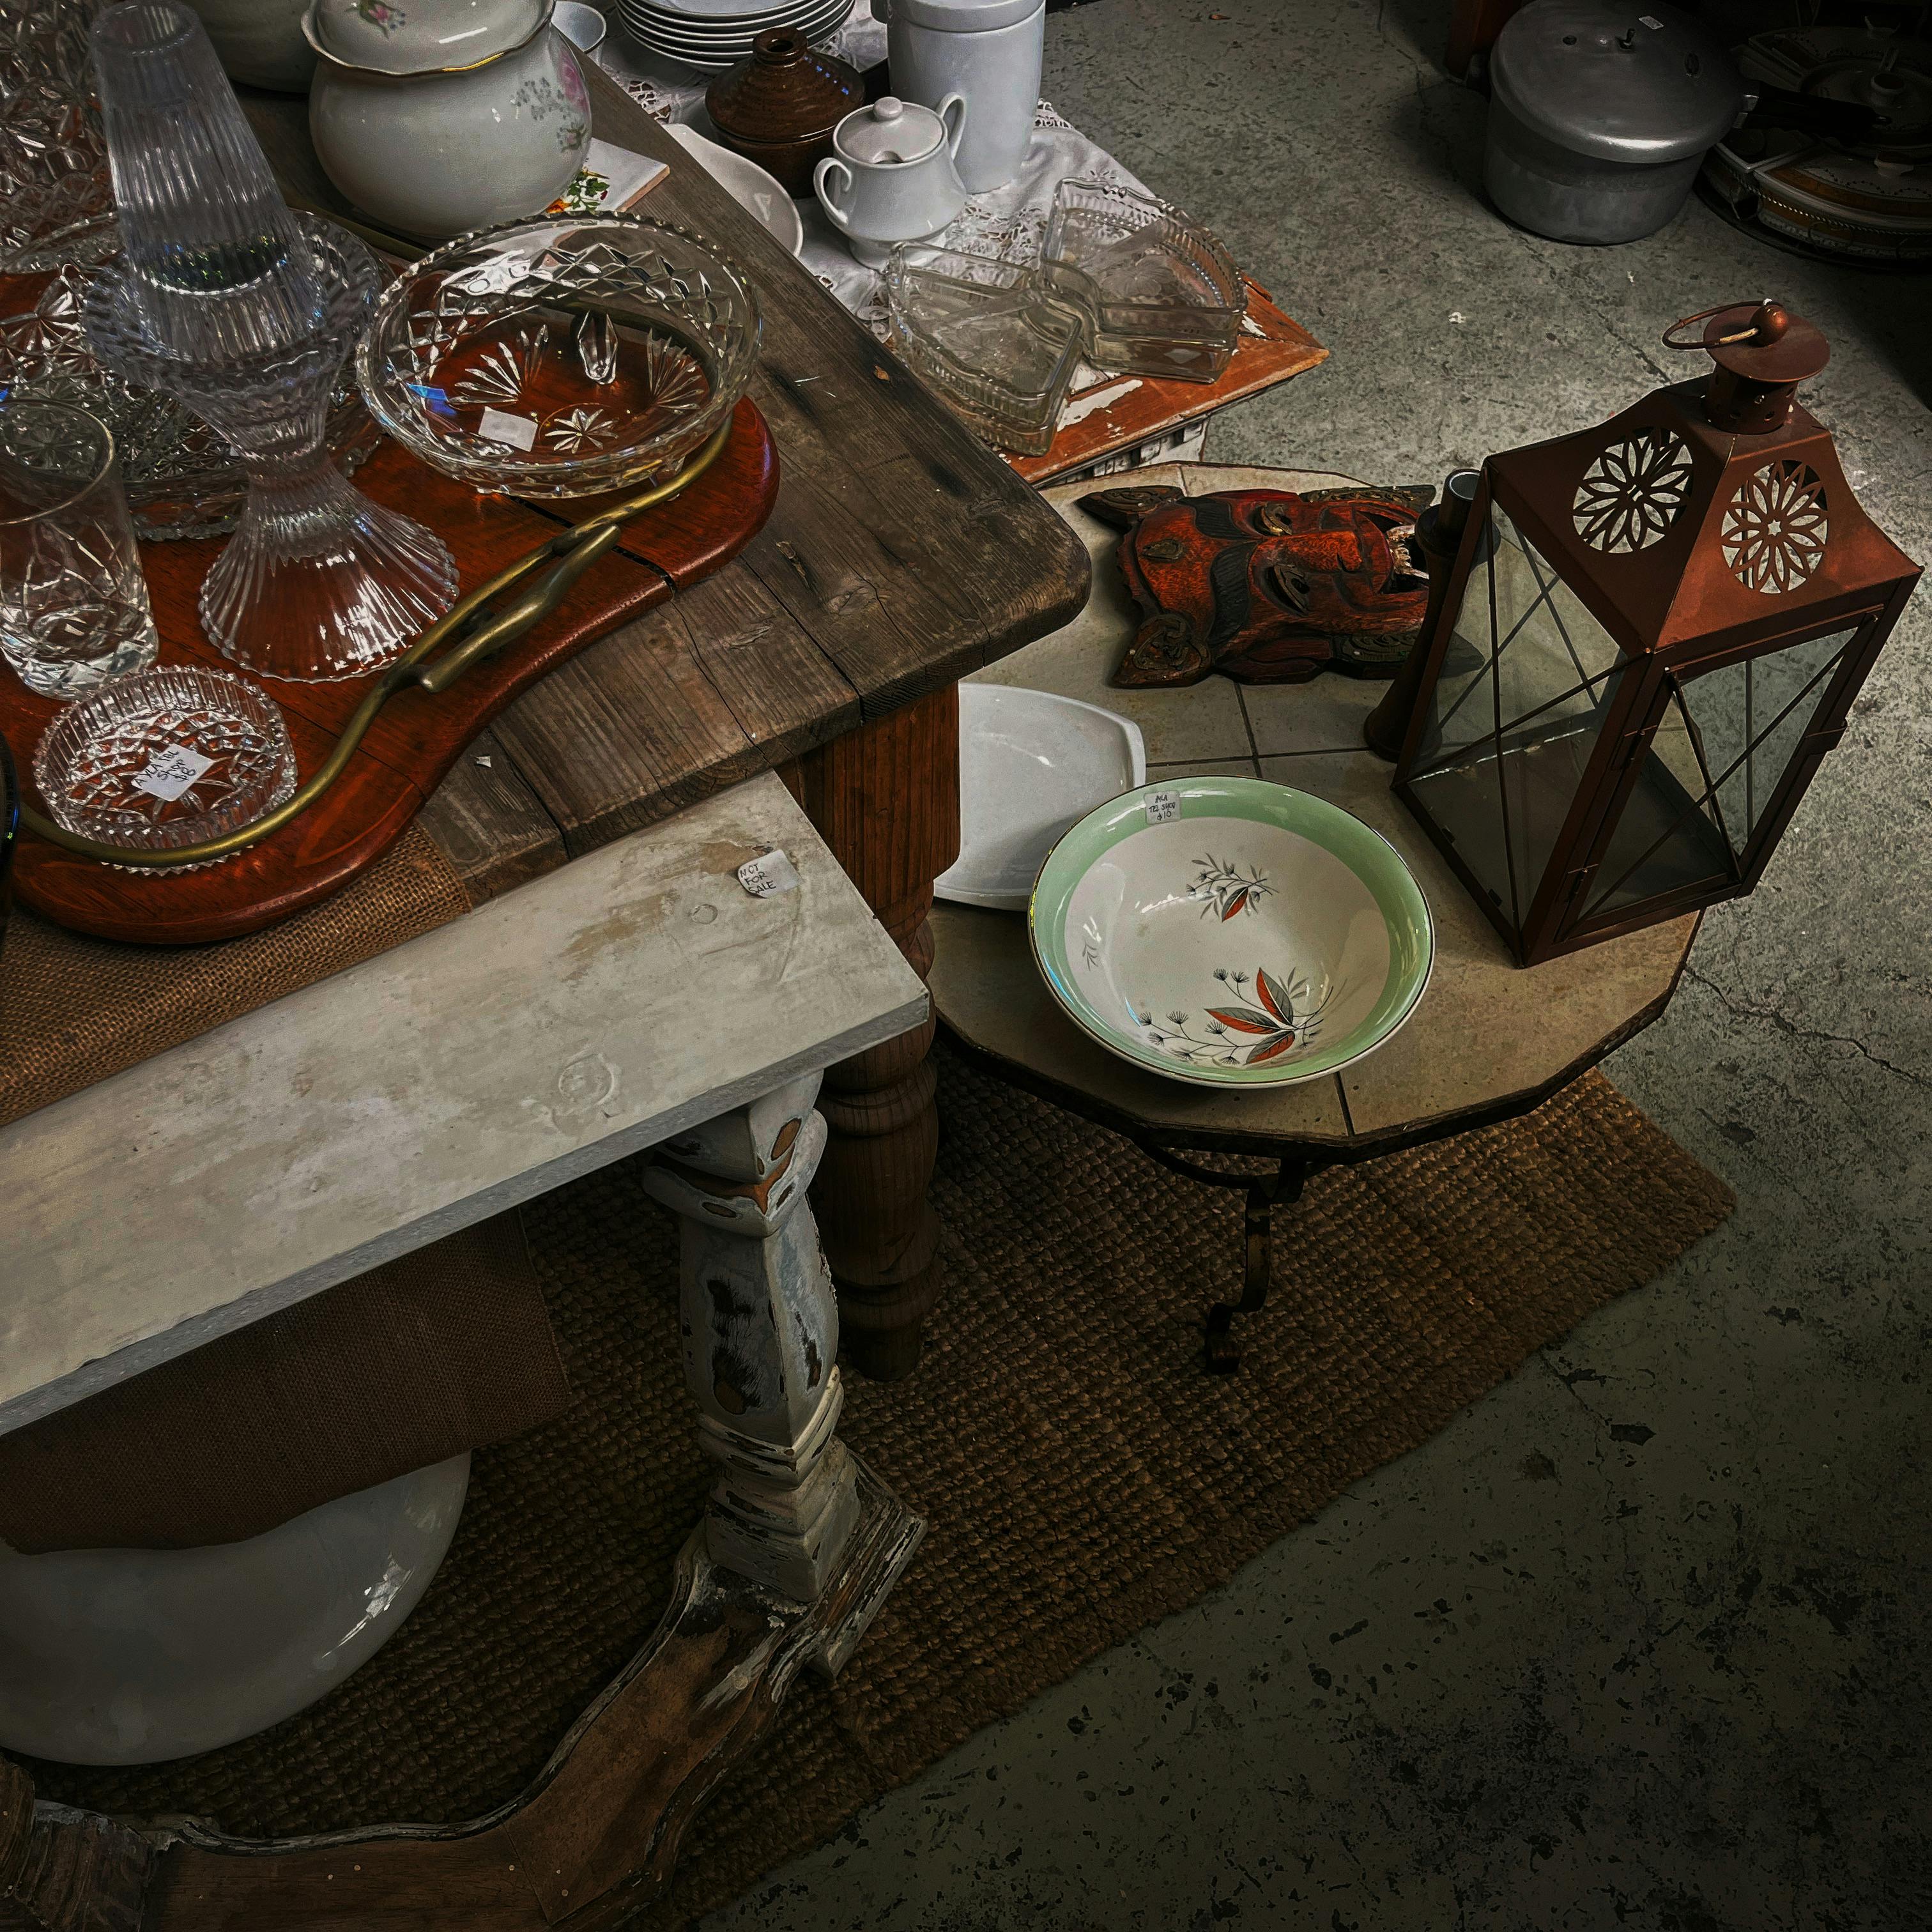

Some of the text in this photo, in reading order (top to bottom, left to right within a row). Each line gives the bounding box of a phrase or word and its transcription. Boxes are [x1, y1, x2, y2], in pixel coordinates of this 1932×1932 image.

[134, 763, 164, 786] AYLA
[740, 863, 759, 878] NOT
[744, 871, 768, 885] FOR
[748, 880, 777, 894] SALE
